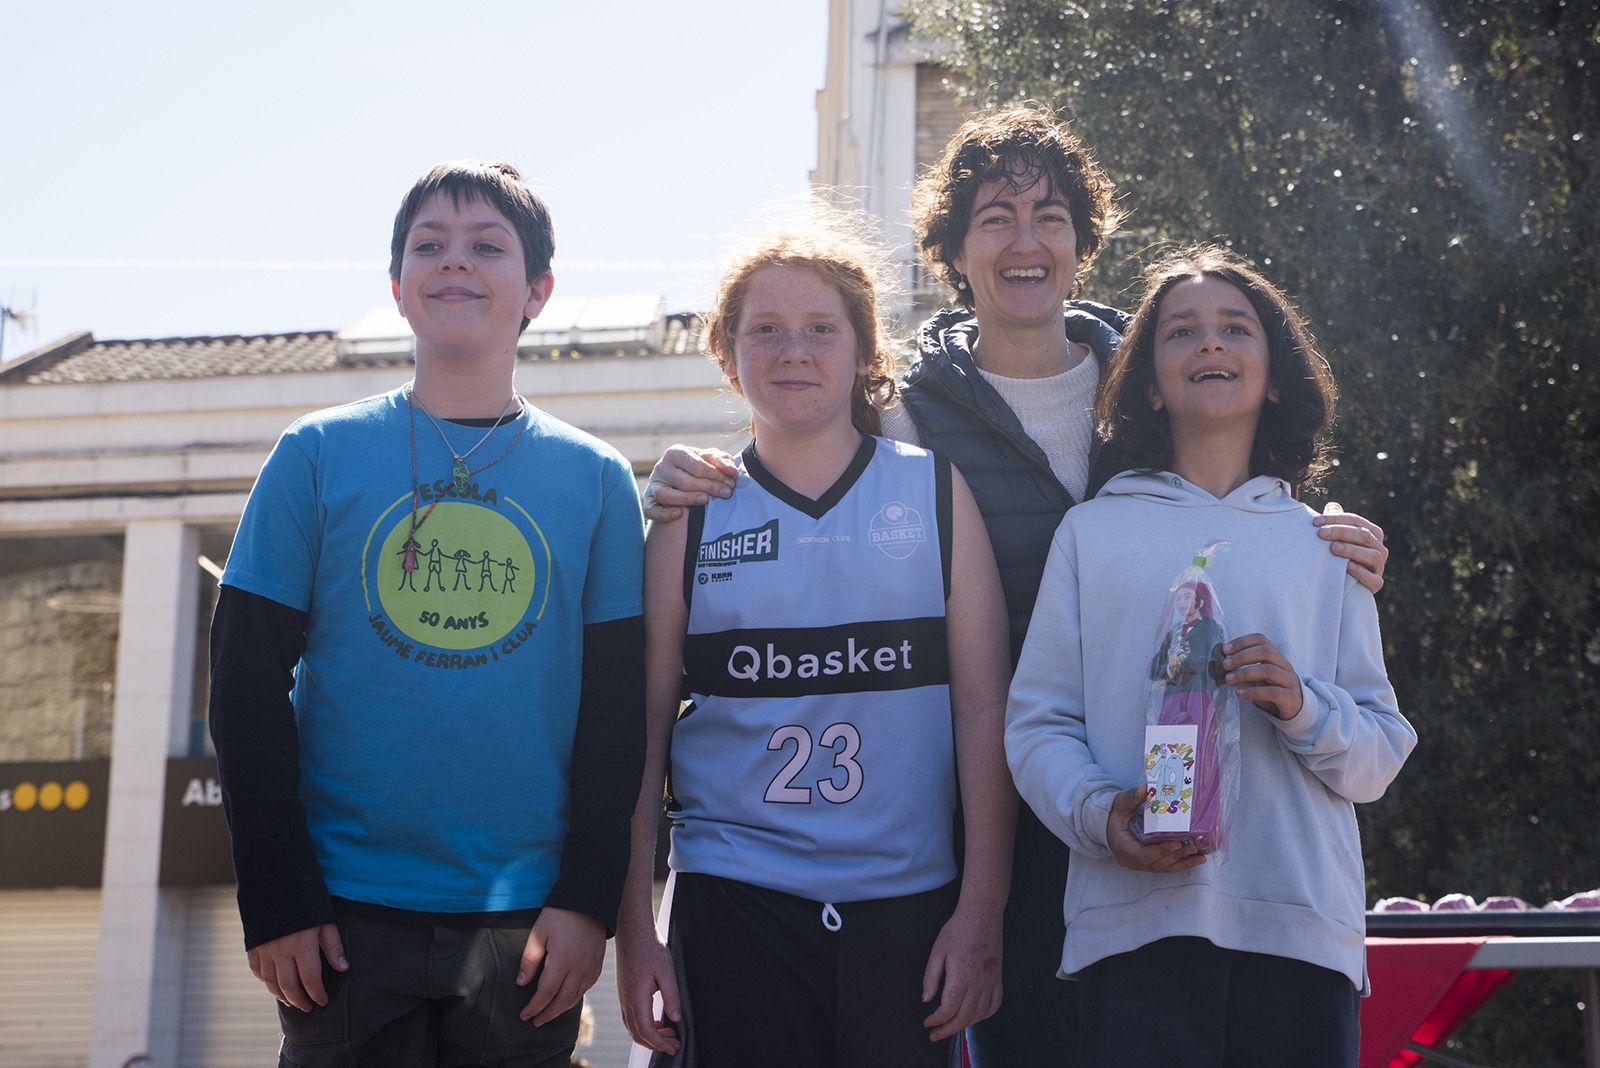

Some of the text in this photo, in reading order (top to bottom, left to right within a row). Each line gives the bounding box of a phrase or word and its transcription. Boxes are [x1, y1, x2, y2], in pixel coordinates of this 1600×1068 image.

[700, 528, 772, 560] FINISHER
[871, 527, 923, 544] BASKET
[711, 572, 733, 580] KERN
[418, 610, 489, 630] 50 ANYS
[368, 613, 414, 660] JAUME
[414, 650, 488, 670] FERRAN
[502, 621, 538, 655] CLUA
[727, 637, 912, 682] Qbasket
[763, 721, 864, 804] 23
